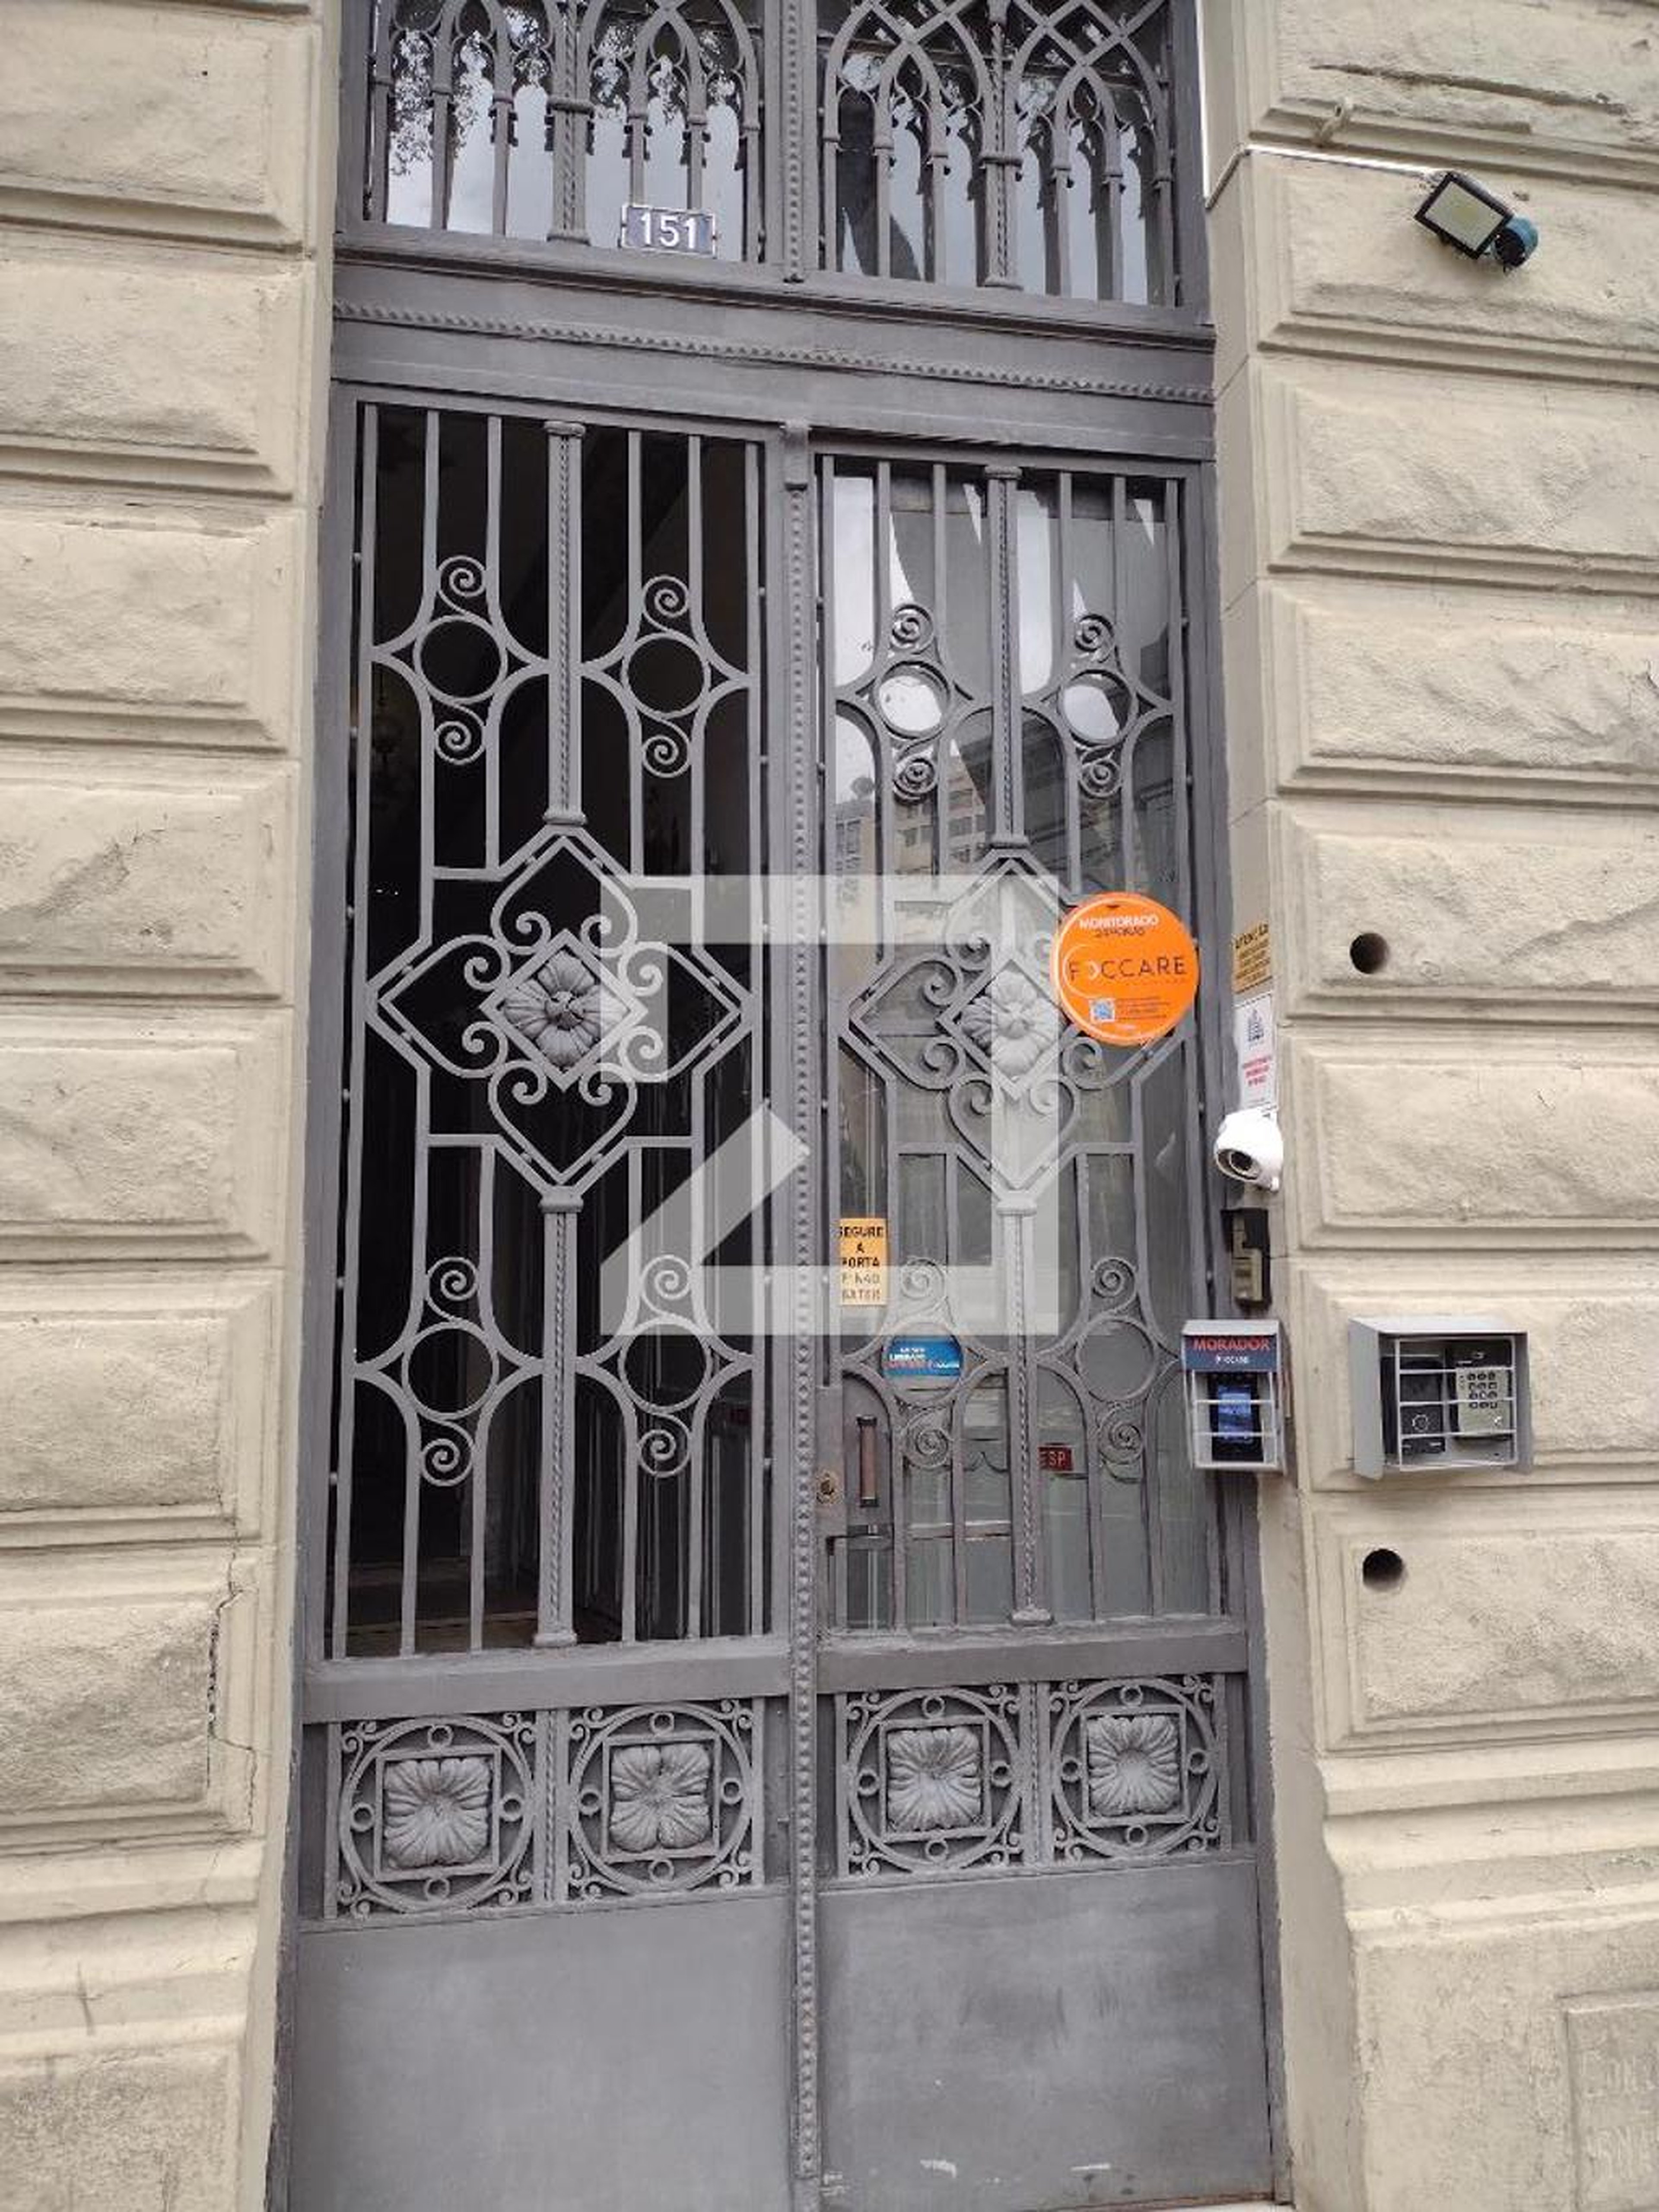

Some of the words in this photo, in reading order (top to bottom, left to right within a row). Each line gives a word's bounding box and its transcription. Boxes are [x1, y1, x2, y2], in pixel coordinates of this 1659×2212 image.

[641, 212, 696, 248] 151
[842, 1257, 880, 1268] PORTA
[1193, 1337, 1270, 1351] MORADOR
